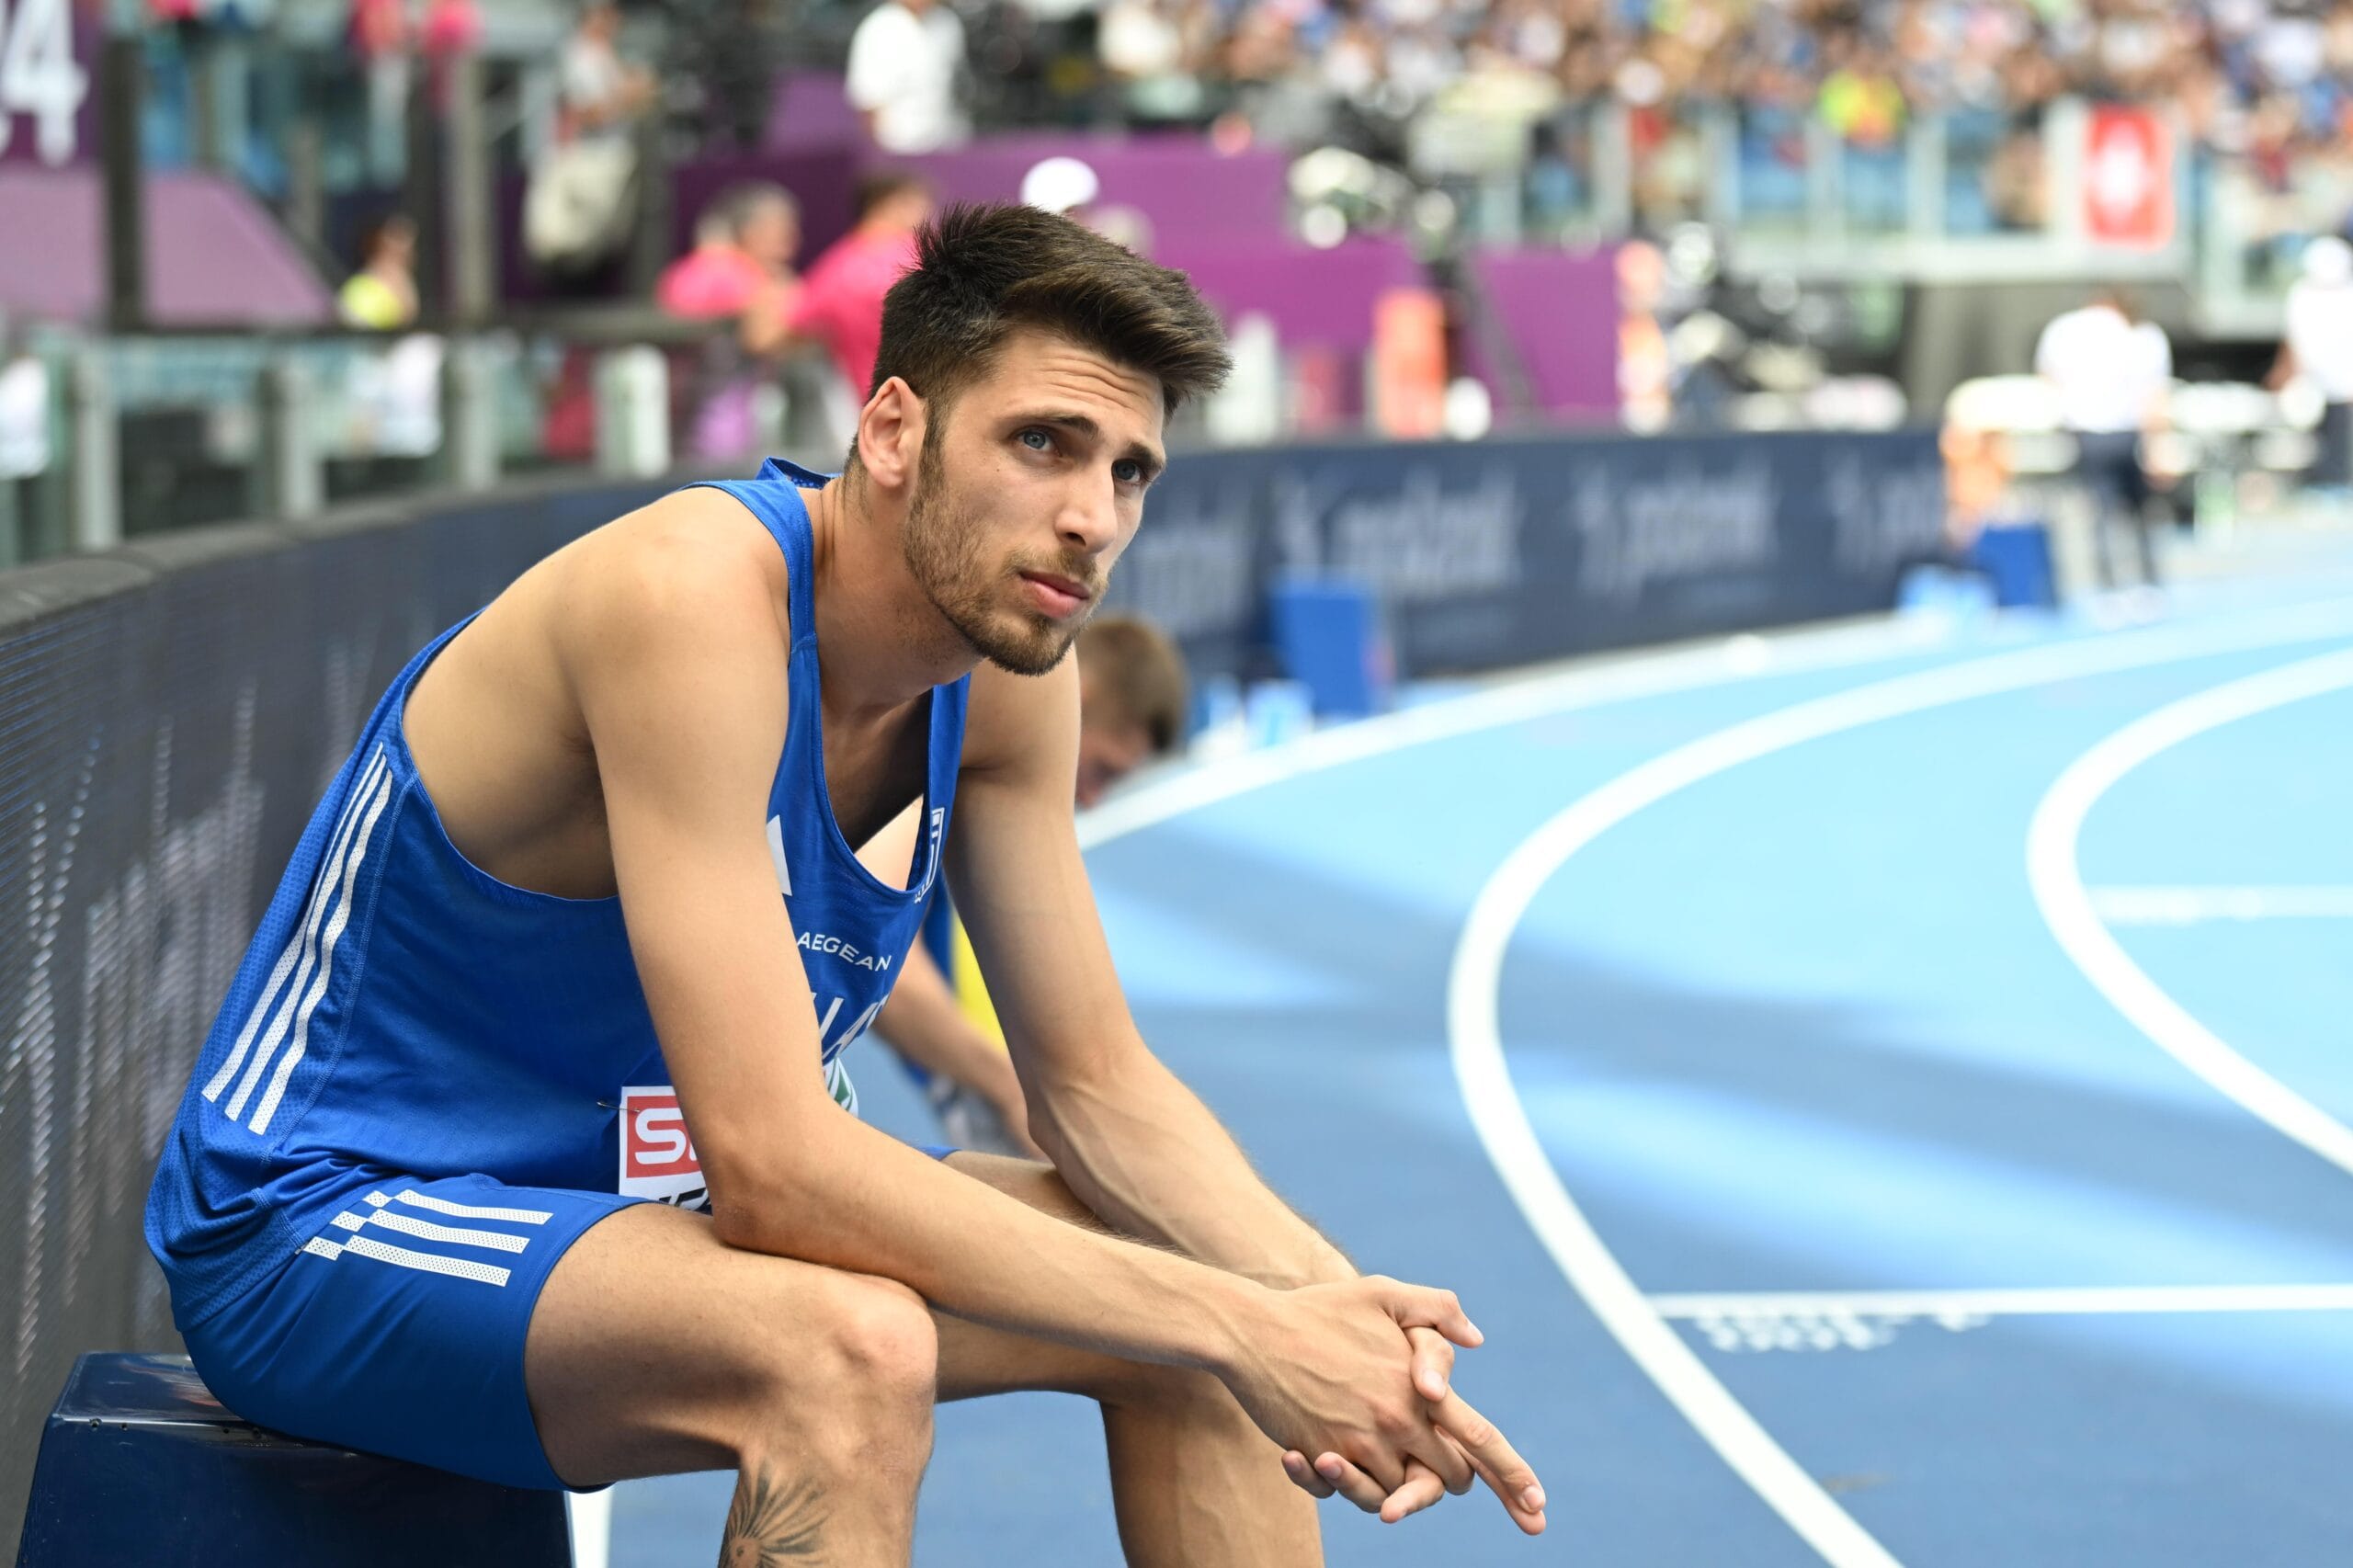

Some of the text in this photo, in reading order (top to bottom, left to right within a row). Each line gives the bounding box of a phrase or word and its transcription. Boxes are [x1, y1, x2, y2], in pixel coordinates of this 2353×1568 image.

[0, 0, 89, 165] 4
[797, 931, 892, 971] AEGEAN
[634, 1107, 698, 1165] S
